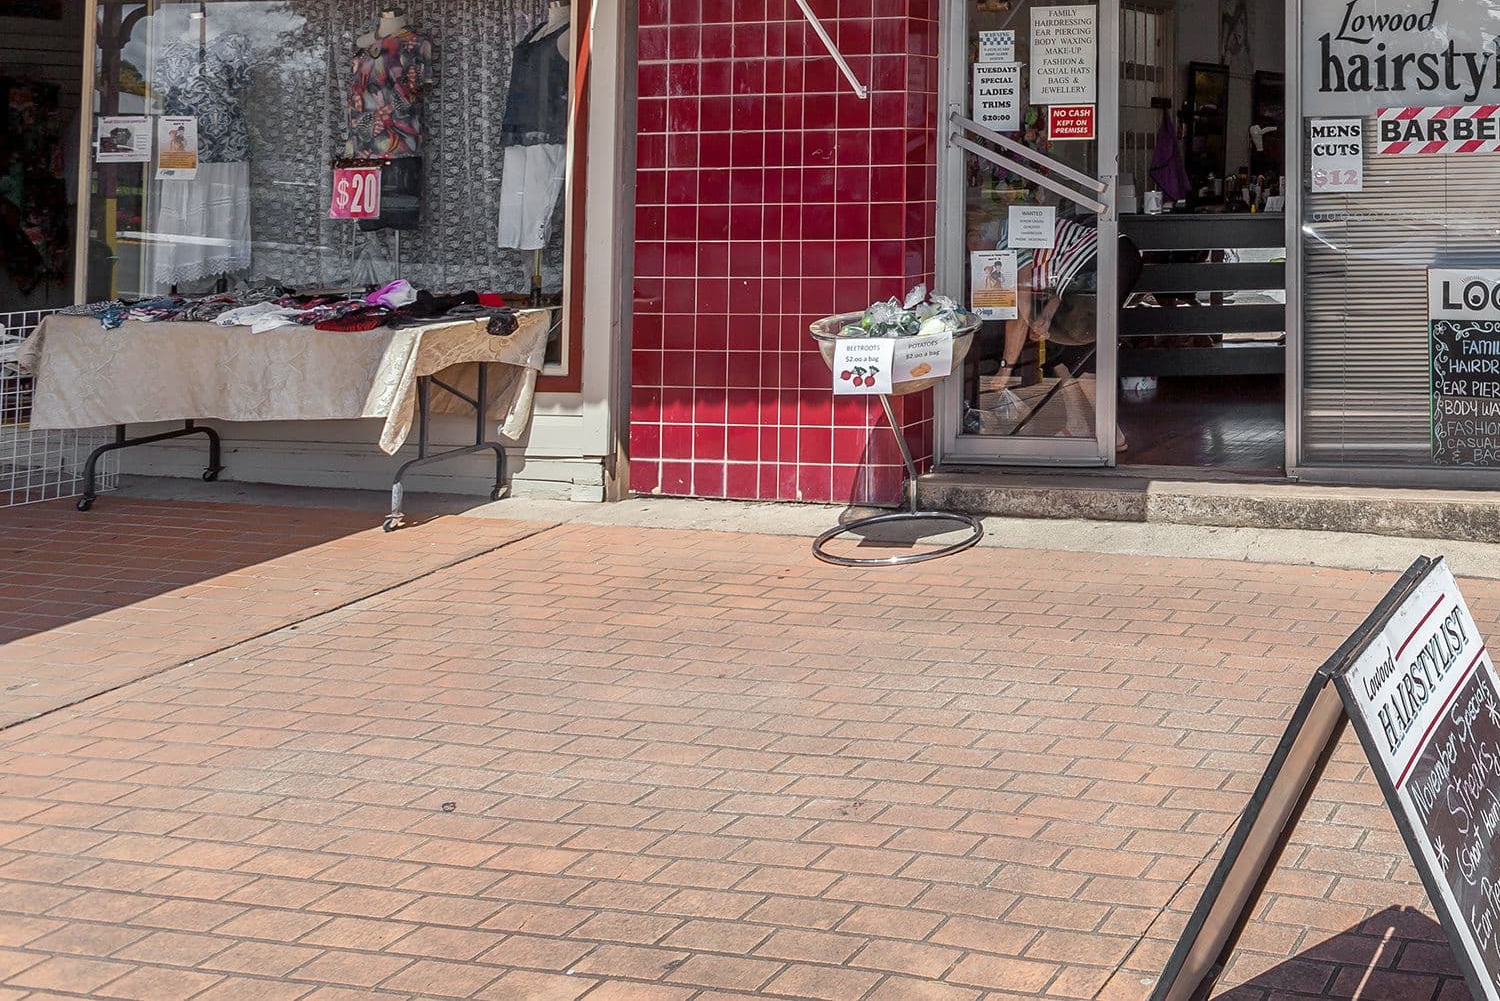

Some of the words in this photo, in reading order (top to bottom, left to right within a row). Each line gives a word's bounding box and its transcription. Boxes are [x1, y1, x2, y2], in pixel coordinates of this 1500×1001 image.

[1048, 9, 1077, 17] FAMILY
[1034, 18, 1092, 27] HAIRDRESSING
[1054, 27, 1091, 36] PIERCING
[1034, 38, 1056, 46] BODY
[1060, 36, 1092, 45] WAXING
[1045, 47, 1082, 55] MAKE-UP
[1042, 58, 1077, 66] FASHION
[976, 66, 1017, 74] TUESDAYS
[1037, 67, 1068, 75] CASUAL
[1070, 66, 1091, 74] HATS
[1048, 76, 1070, 85] BAGS
[1072, 76, 1080, 84] &
[979, 88, 1014, 96] LADIES
[1040, 85, 1087, 95] JEWELLERY
[982, 100, 1011, 108] TRIMS
[1053, 109, 1067, 117] NO
[1068, 109, 1091, 117] CASH
[1056, 119, 1074, 127] KEPT
[1311, 125, 1361, 139] MENS
[1313, 143, 1360, 157] CUTS
[1314, 168, 1359, 189] $12
[336, 173, 376, 214] $20
[846, 344, 881, 352] BEETROOTS
[908, 340, 938, 349] POTATOES
[1443, 379, 1467, 396] EAR
[1444, 399, 1478, 417] BODY
[1447, 437, 1500, 449] CASUAL
[1362, 645, 1396, 702] Lowood
[1377, 604, 1469, 756] HAIRSTYLIST
[1411, 731, 1458, 826] November
[1450, 671, 1491, 753] Specials
[1447, 742, 1494, 834] Streaks
[1470, 904, 1493, 952] Ear
